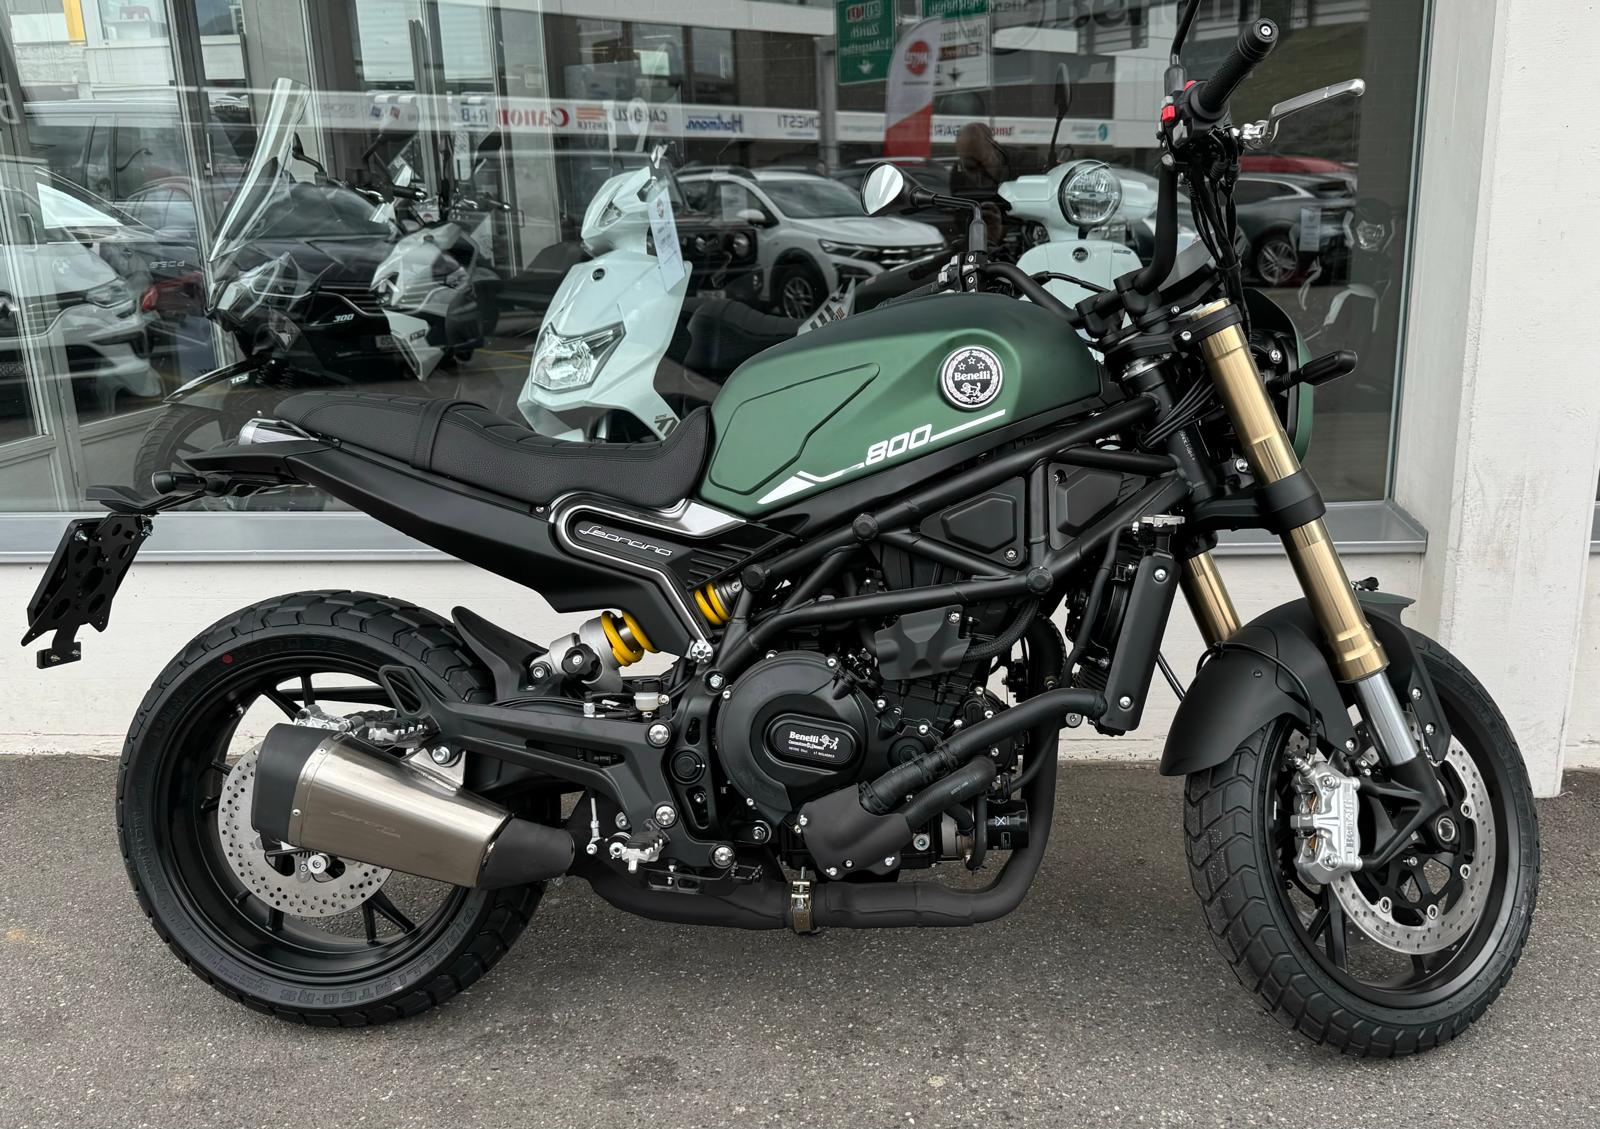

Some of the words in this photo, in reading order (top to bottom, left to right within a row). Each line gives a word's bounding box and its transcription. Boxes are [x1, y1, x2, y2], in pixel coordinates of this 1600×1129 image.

[953, 370, 992, 381] Benelli
[865, 423, 932, 466] 800
[789, 731, 819, 744] Benelli
